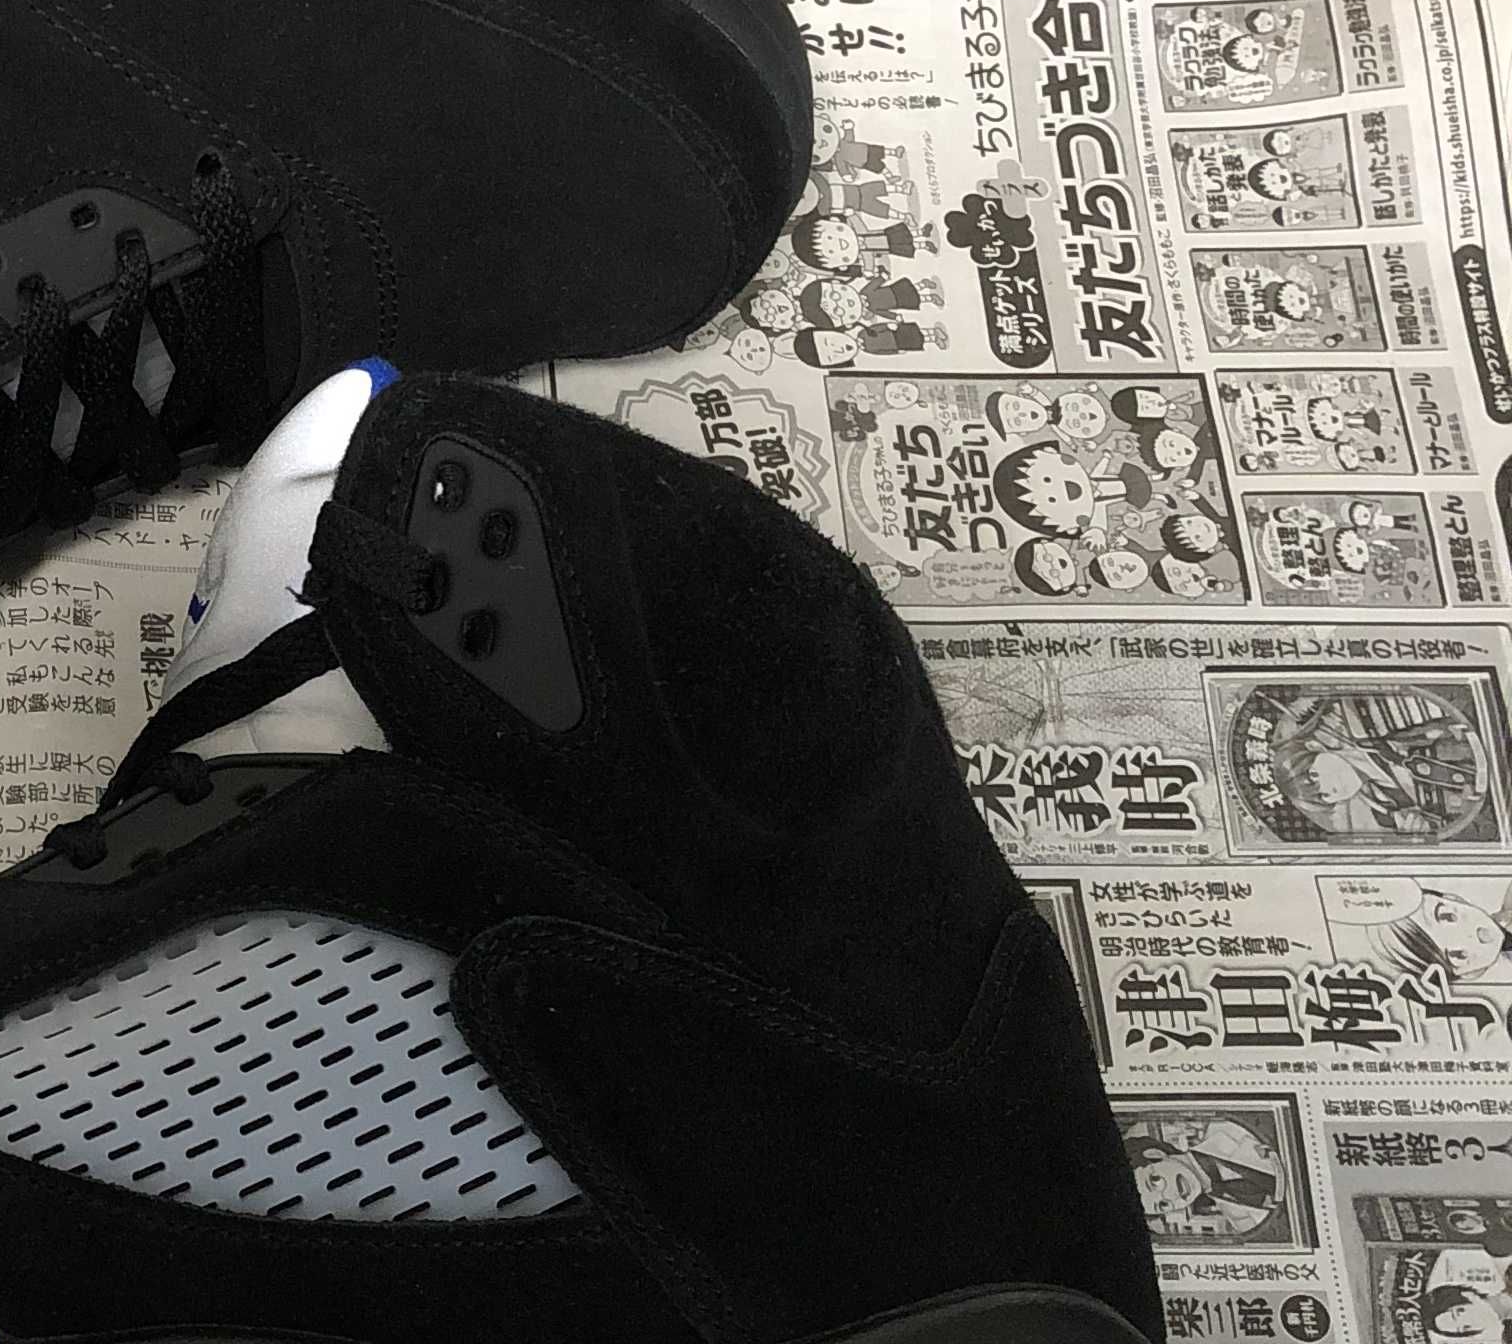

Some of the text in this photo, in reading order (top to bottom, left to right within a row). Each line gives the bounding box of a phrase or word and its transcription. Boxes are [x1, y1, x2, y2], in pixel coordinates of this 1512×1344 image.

[1179, 27, 1201, 90] ラクラク
[1361, 110, 1398, 220] 話しかたと発表
[975, 198, 1003, 258] せいかつ
[991, 269, 1023, 355] 満点ゲット
[1020, 276, 1048, 346] シリーズ
[1224, 276, 1249, 326] 時間の
[1382, 245, 1422, 345] 時間の使いかた
[1410, 372, 1451, 470] マナーとルール
[893, 425, 957, 551] 友だち
[946, 423, 1006, 553] づき合い
[1441, 495, 1484, 602] 整理整とん
[1246, 716, 1284, 808] 北条義時
[1090, 881, 1253, 904] 女性が学ぶ道を
[1095, 908, 1232, 928] きりひらいた
[1100, 934, 1312, 957] 明治時代の教育者！
[1115, 969, 1495, 1053] 津田梅子
[1166, 1297, 1275, 1338] 柴三郎
